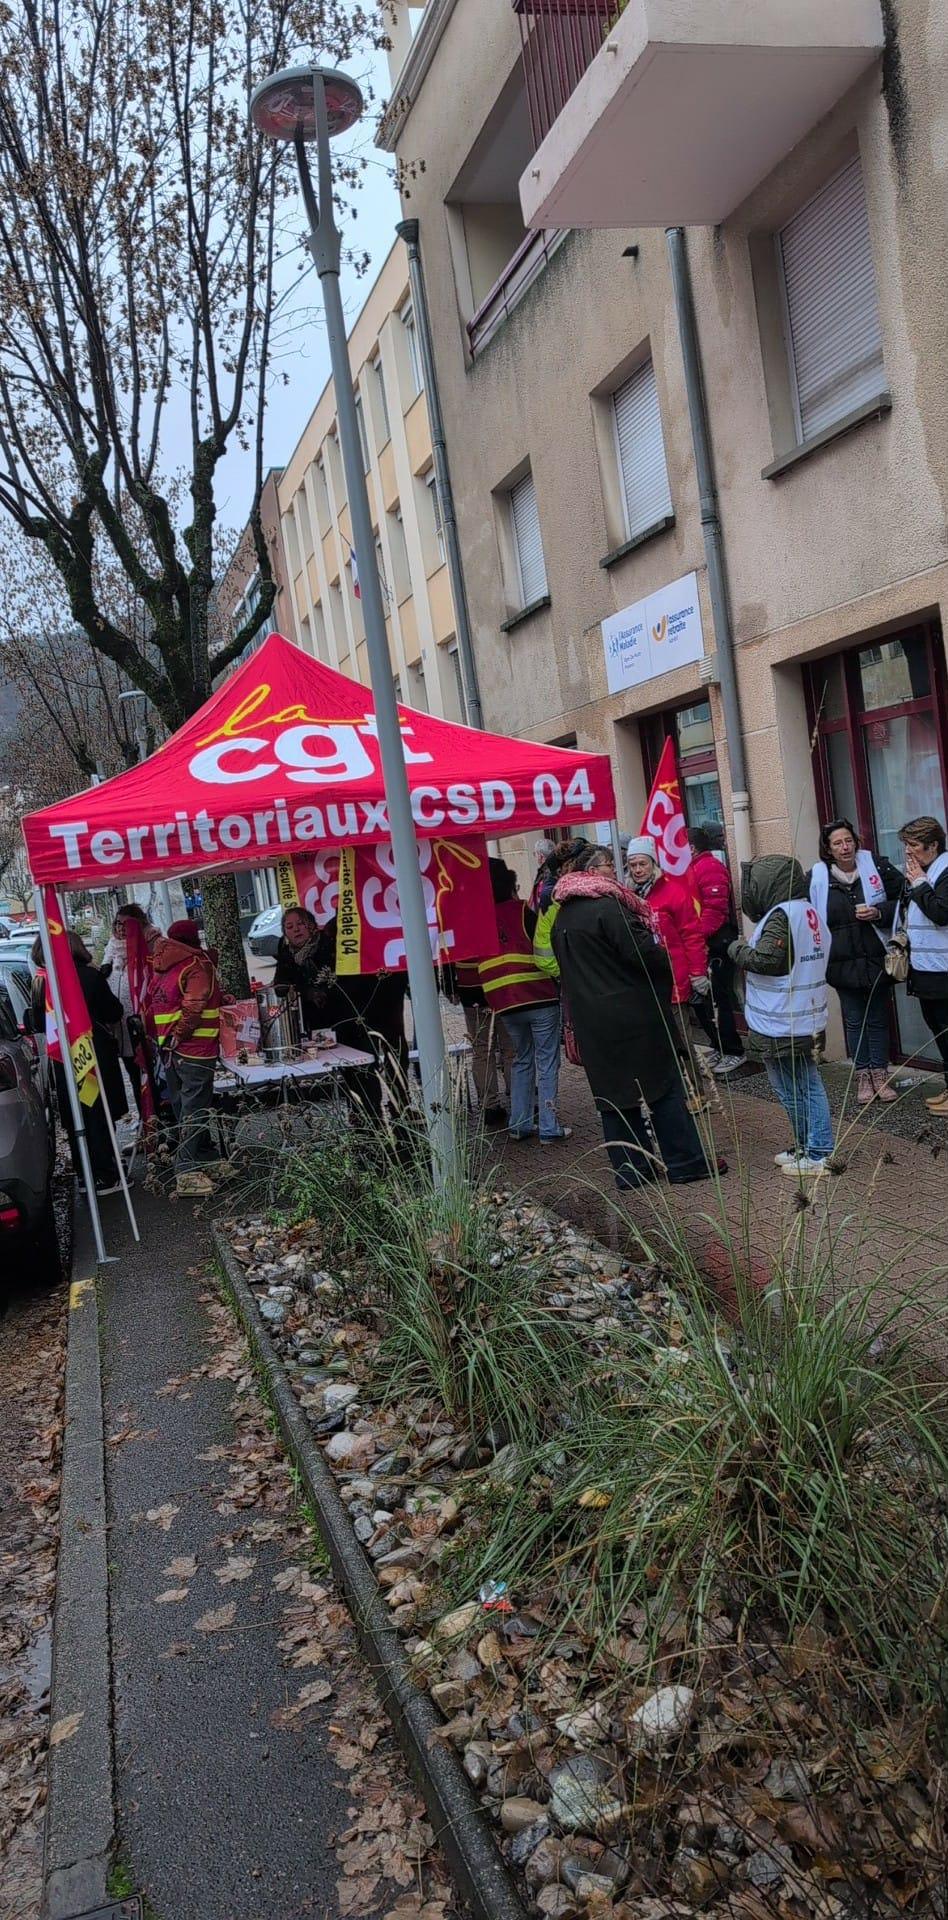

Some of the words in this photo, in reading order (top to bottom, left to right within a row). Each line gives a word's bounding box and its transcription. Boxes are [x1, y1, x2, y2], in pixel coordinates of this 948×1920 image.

[195, 684, 390, 746] la
[188, 713, 434, 784] cgt
[48, 798, 390, 870] Territoriaux
[409, 780, 516, 828] CSD
[532, 768, 596, 817] 04
[278, 860, 295, 900] Sécurité
[341, 938, 359, 956] 04
